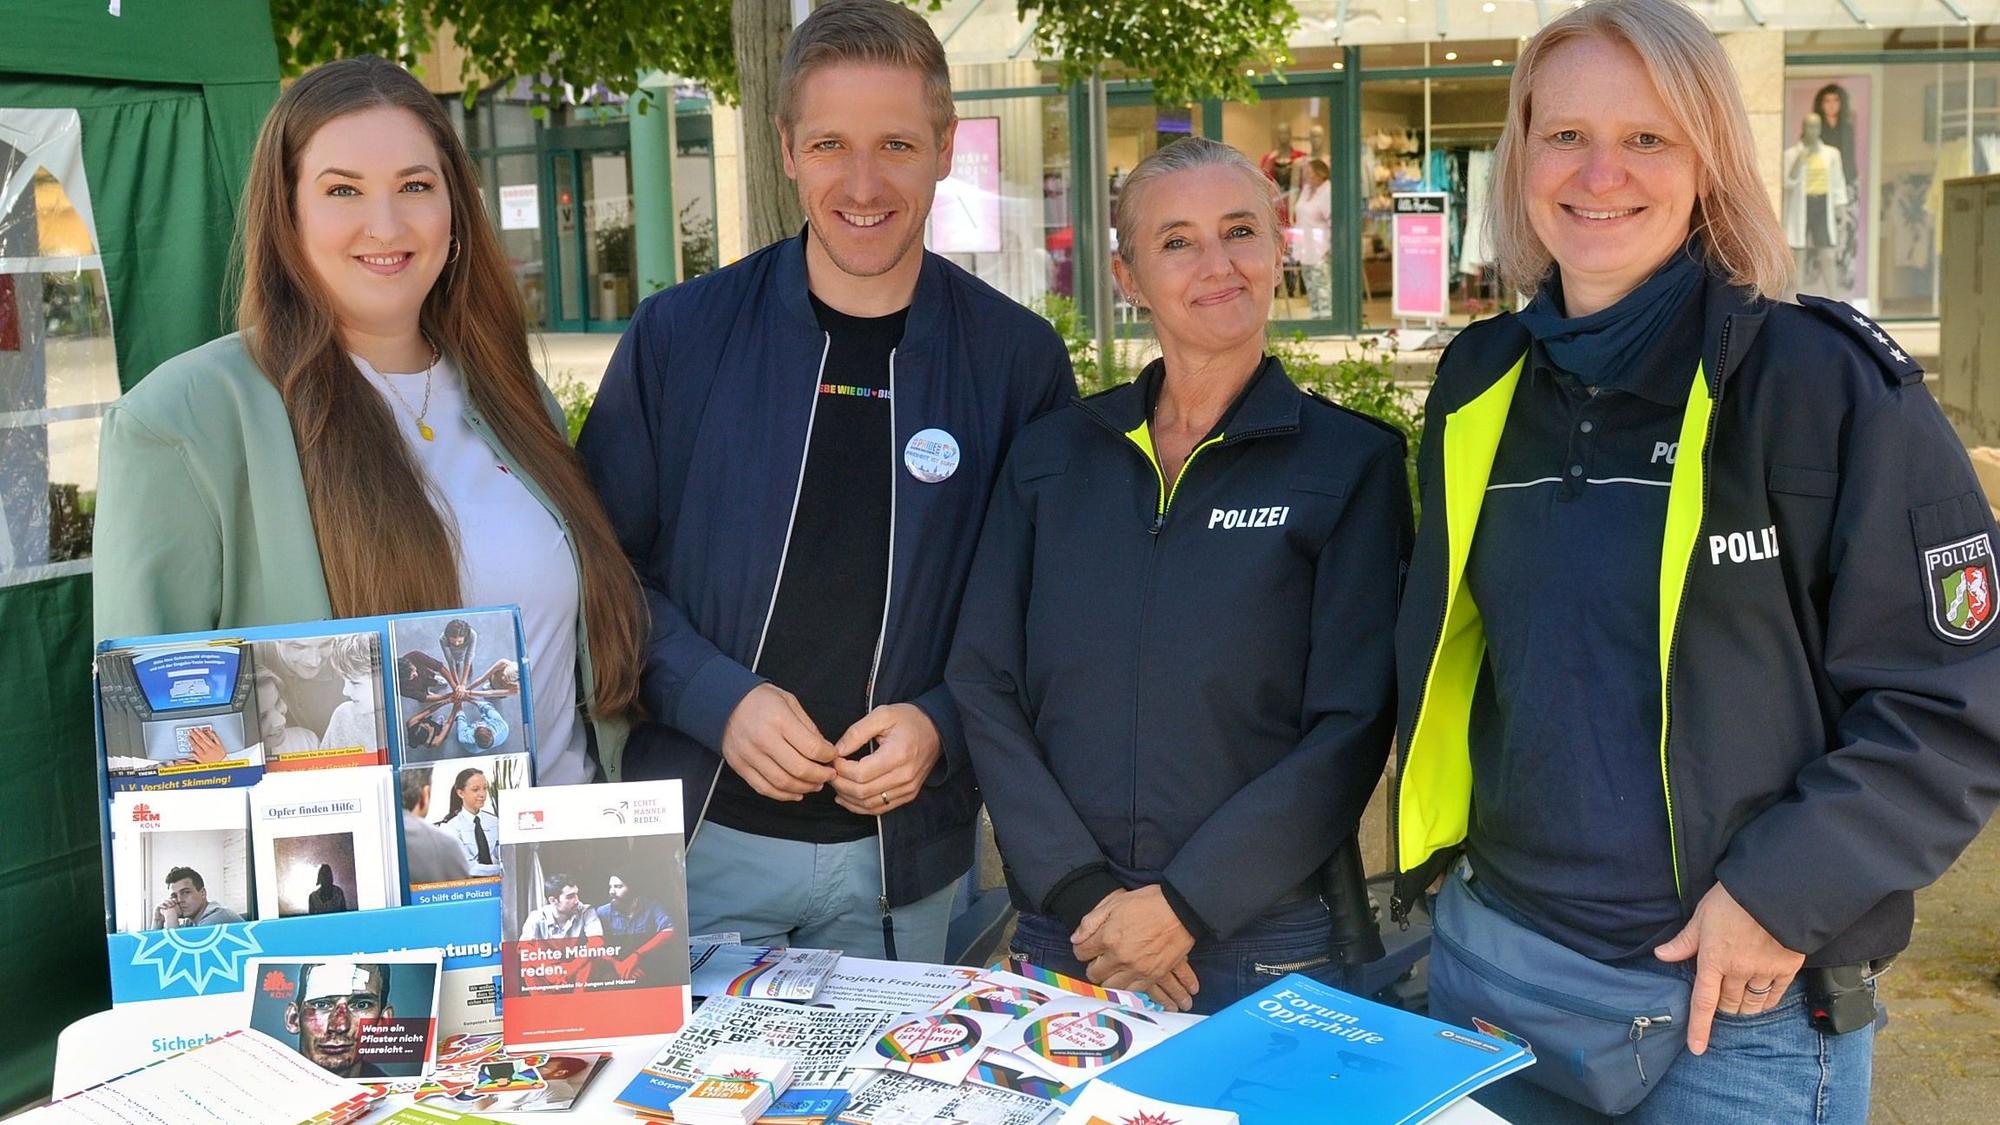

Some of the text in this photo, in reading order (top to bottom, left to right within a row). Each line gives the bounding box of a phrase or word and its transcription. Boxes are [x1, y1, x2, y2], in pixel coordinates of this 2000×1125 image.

[818, 384, 836, 394] EBE
[837, 385, 856, 396] WIE
[857, 387, 871, 397] DU
[1207, 506, 1290, 530] POLIZEI
[1929, 538, 1990, 571] POLIZEI
[138, 770, 157, 778] THEMA
[140, 780, 181, 791] Vorsicht
[182, 775, 232, 789] Skimming!
[132, 813, 160, 822] SKM
[268, 801, 355, 819] Opfer finden Hilfe
[420, 888, 492, 904] So hilft die Polizei
[440, 943, 502, 958] tung.
[520, 943, 621, 962] Echte Männer
[520, 962, 568, 978] reden.
[575, 981, 585, 989] für
[585, 980, 604, 989] Jungen
[616, 978, 636, 986] Männer
[831, 973, 957, 991] Projekt Freiraum
[740, 1001, 804, 1016] WURDEN
[809, 1011, 877, 1019] VERLETZT
[1273, 988, 1360, 1025] Forum
[362, 1023, 405, 1033] Wenn ein
[761, 1023, 866, 1036] SEELISCHE
[1258, 1000, 1385, 1045] Opferhilfe
[360, 1033, 424, 1044] Pflaster nicht
[685, 1025, 724, 1038] SIE
[903, 1026, 963, 1036] Die Welt
[152, 1033, 216, 1053] Sicherh
[358, 1044, 403, 1055] ausreicht
[666, 1049, 695, 1059] UND
[651, 1065, 702, 1081] KOMPETE
[876, 1078, 930, 1093] NICHT
[855, 1096, 884, 1104] UND
